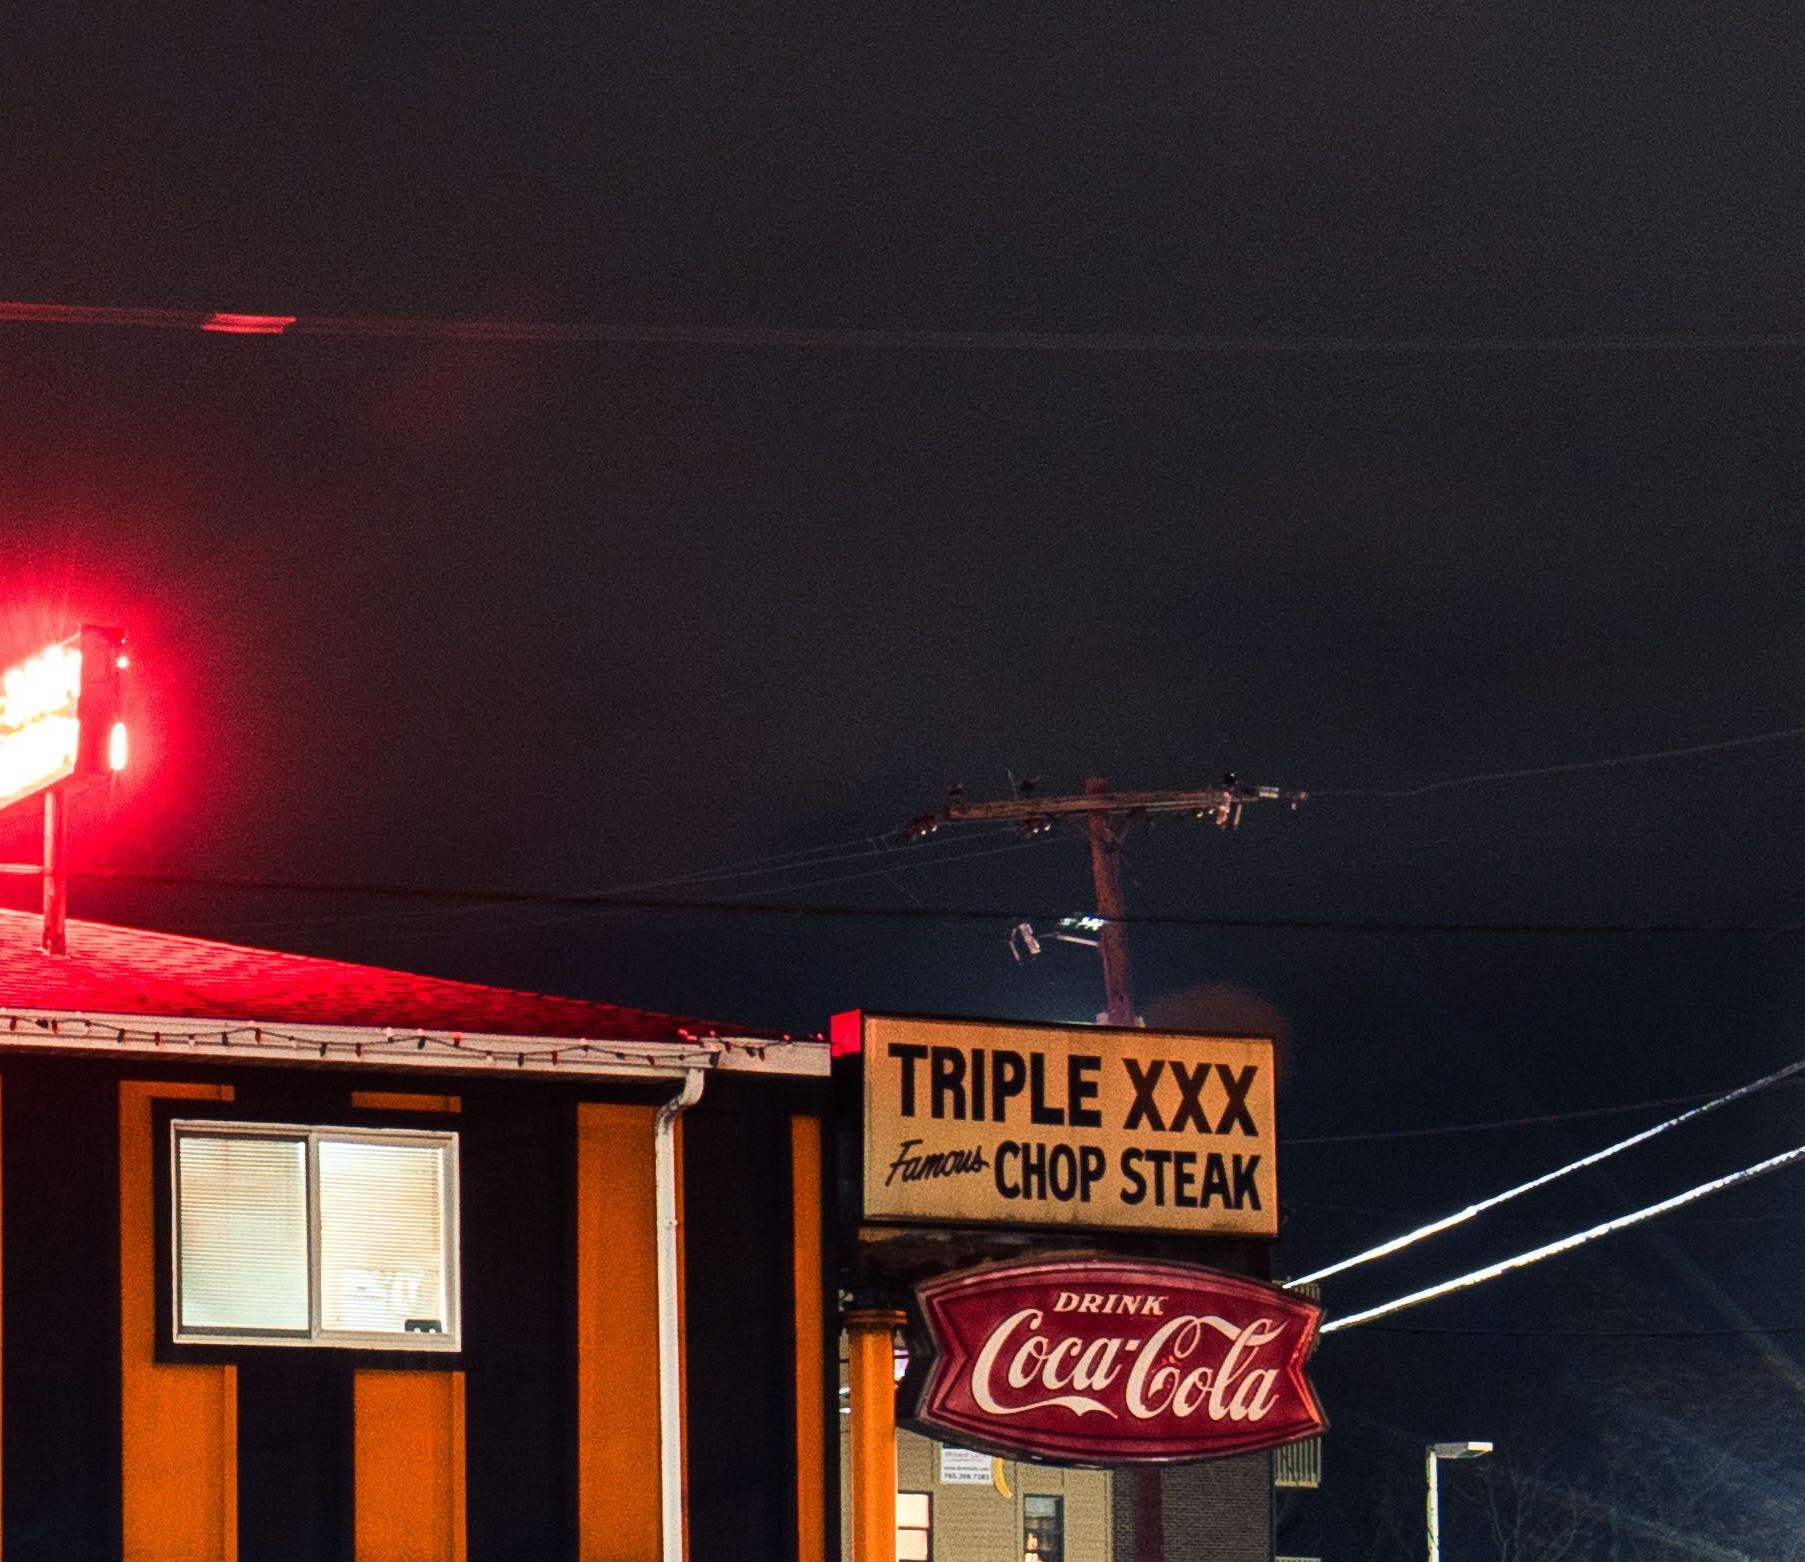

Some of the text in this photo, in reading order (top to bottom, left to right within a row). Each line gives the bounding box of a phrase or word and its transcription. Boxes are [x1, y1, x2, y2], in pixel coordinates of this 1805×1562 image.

[888, 1043, 1259, 1137] TRIPLE XXX
[885, 1138, 1262, 1211] Famous CHOP STEAK
[1053, 1292, 1169, 1316] DRINK
[972, 1308, 1288, 1422] Coca-Cola
